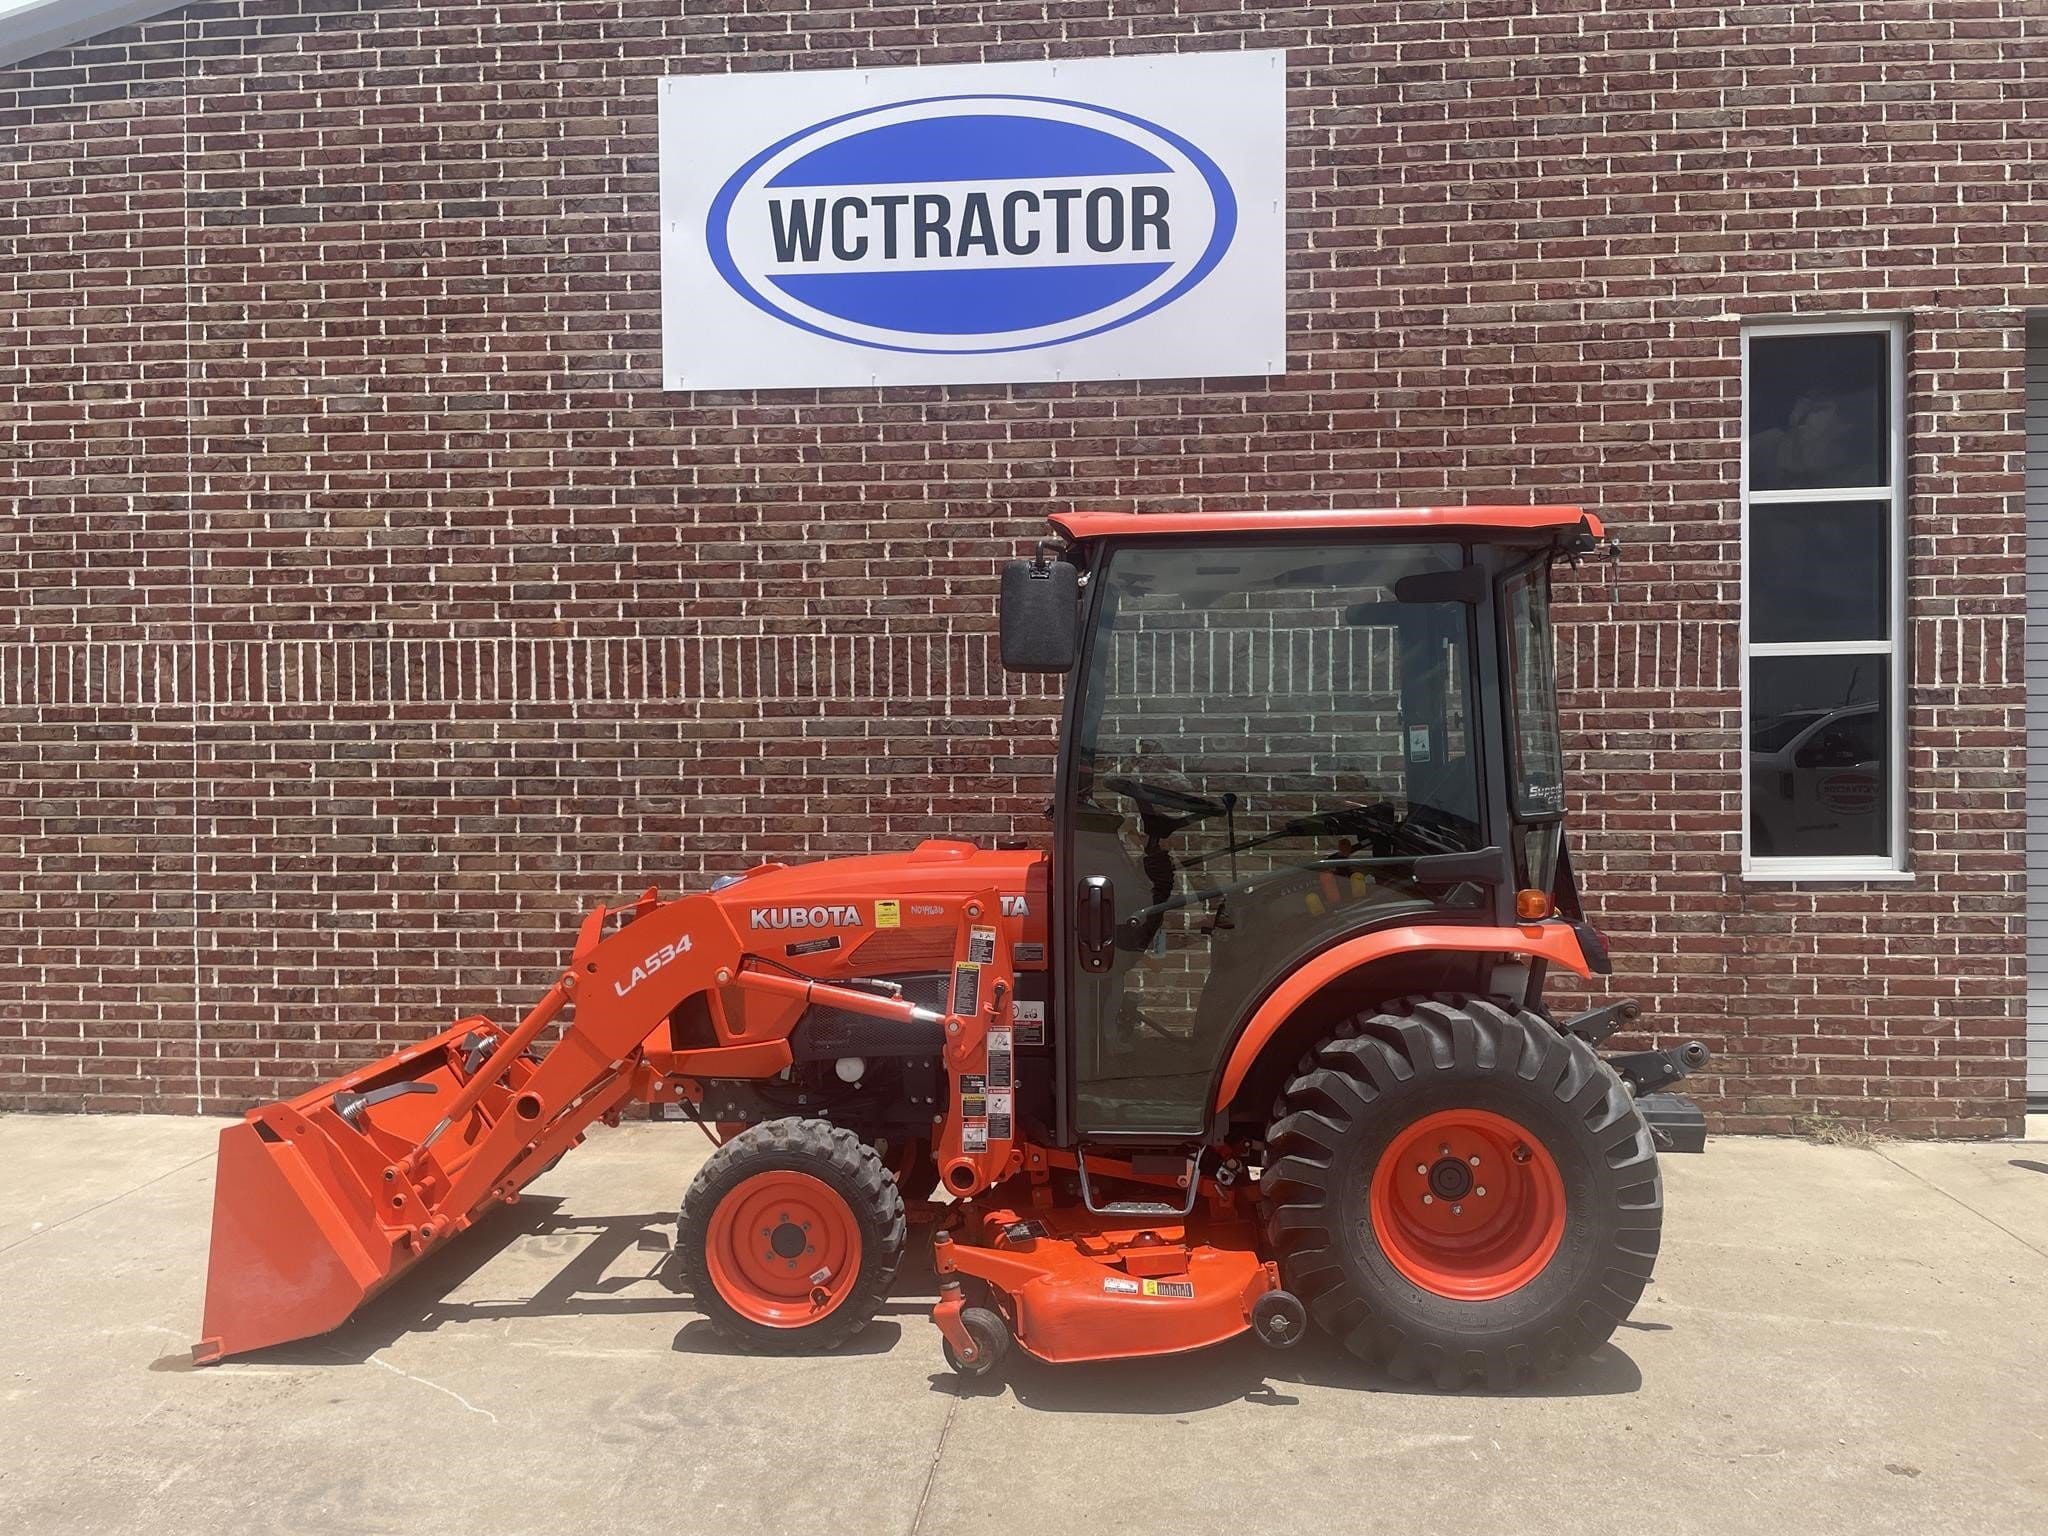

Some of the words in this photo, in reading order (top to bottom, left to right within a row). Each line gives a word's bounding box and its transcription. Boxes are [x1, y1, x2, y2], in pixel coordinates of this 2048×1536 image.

[768, 185, 1171, 263] WCTRACTOR
[751, 905, 863, 929] KUBOTA
[614, 934, 693, 997] LA534
